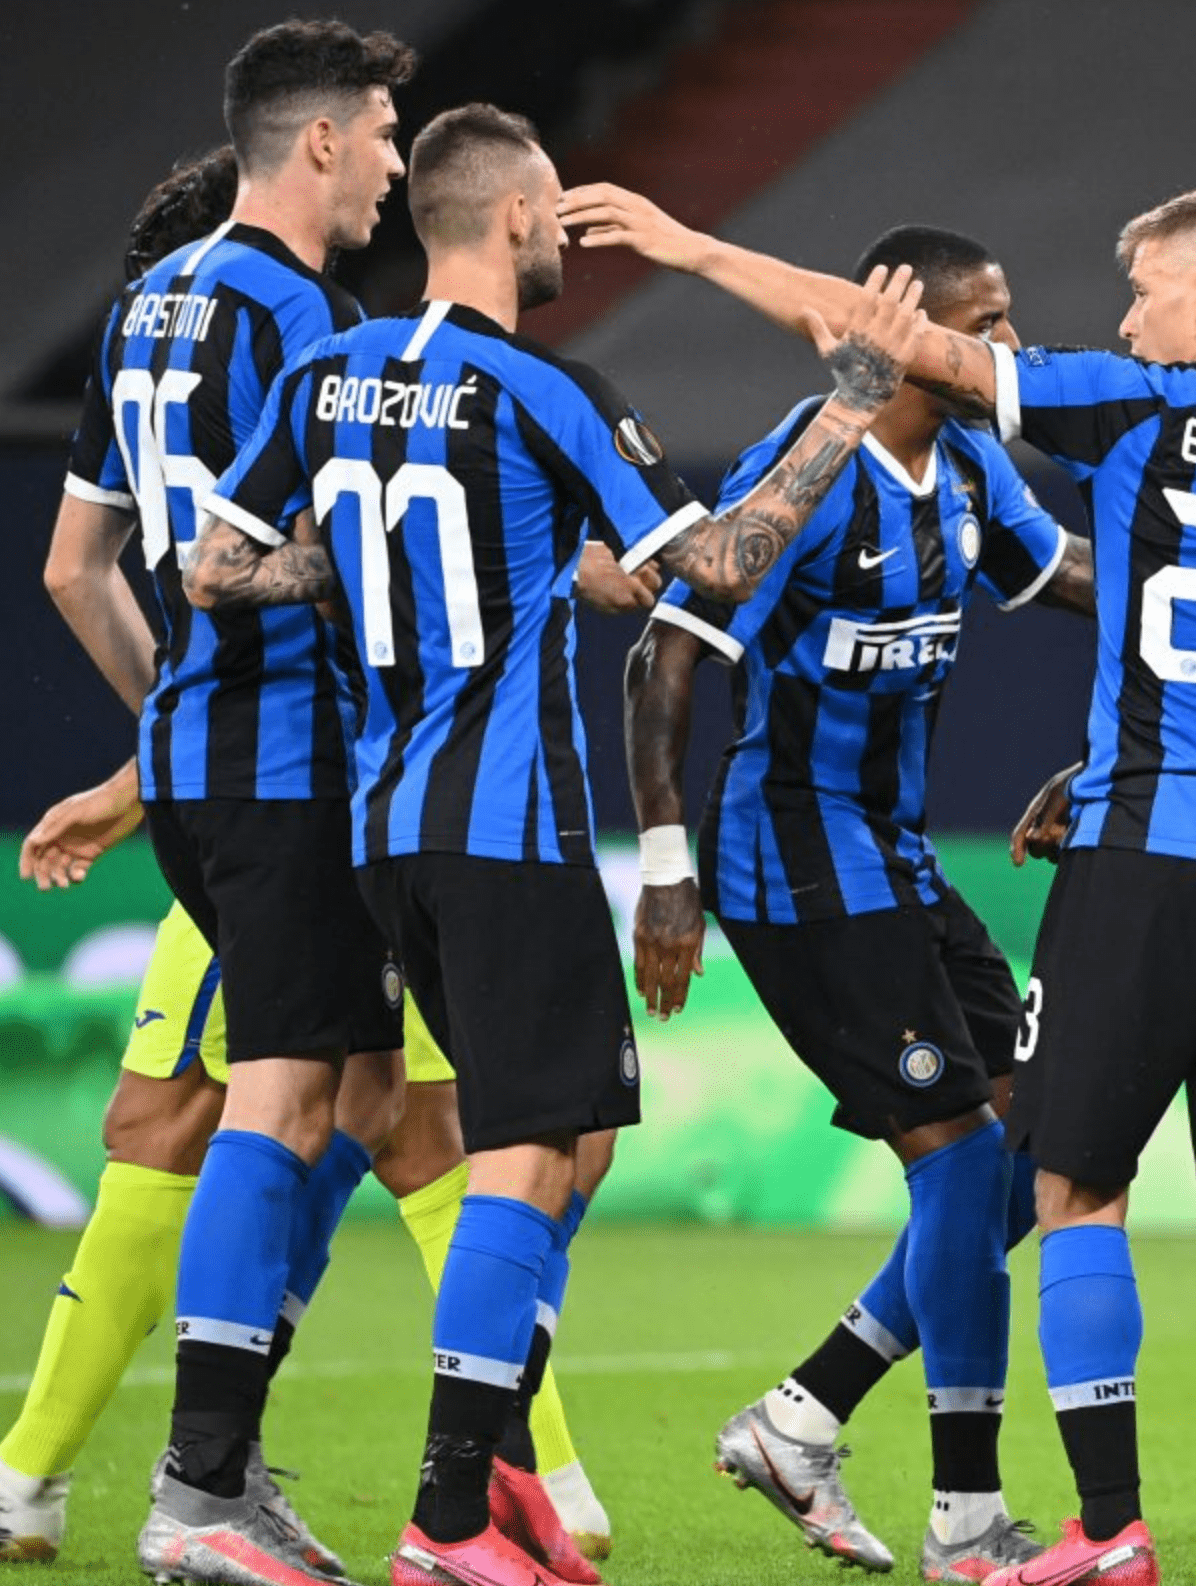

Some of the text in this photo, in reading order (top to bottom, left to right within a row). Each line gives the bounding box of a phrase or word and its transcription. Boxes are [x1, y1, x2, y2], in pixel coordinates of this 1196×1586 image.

[122, 293, 218, 342] BASTONI
[316, 374, 478, 430] BROZOVIĆ
[312, 457, 485, 667] 77
